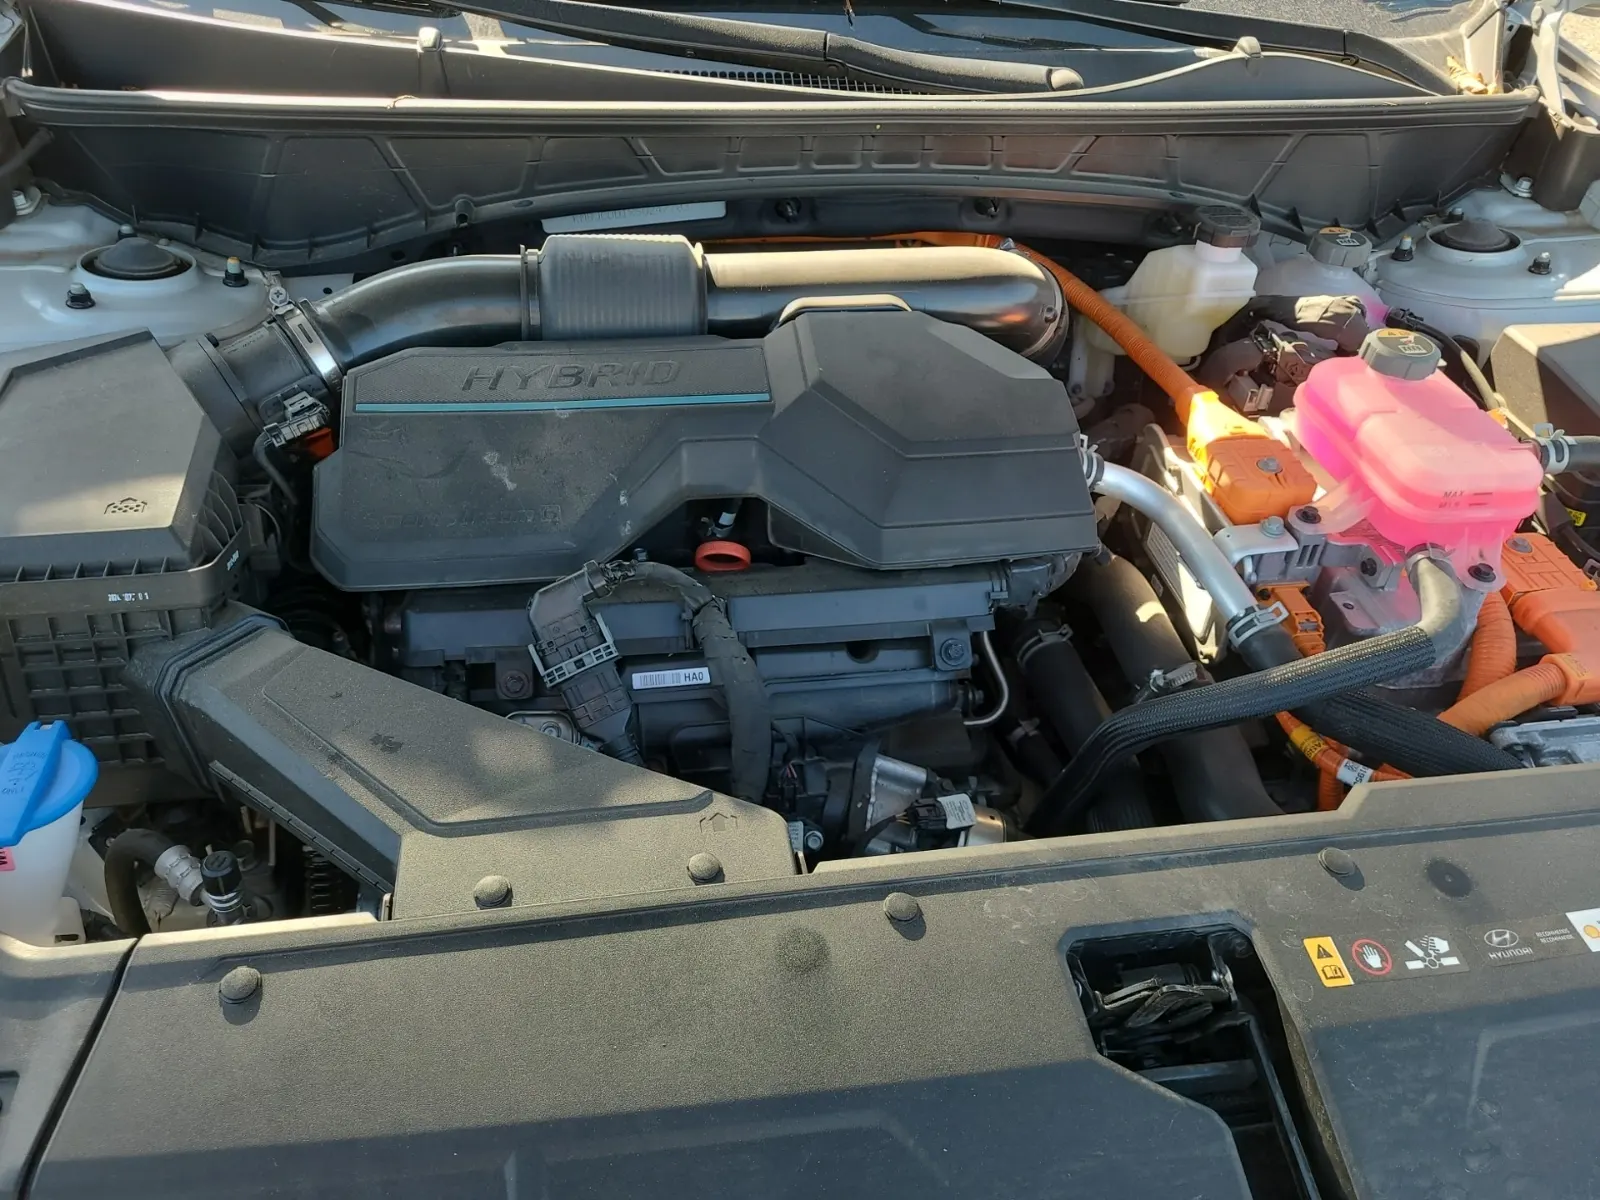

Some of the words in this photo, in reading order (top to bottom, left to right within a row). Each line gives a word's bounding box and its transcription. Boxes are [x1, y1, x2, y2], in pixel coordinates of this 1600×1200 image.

[462, 360, 682, 391] HYBRID
[1443, 490, 1465, 498] MAX
[1487, 946, 1534, 961] HYUNDAI
